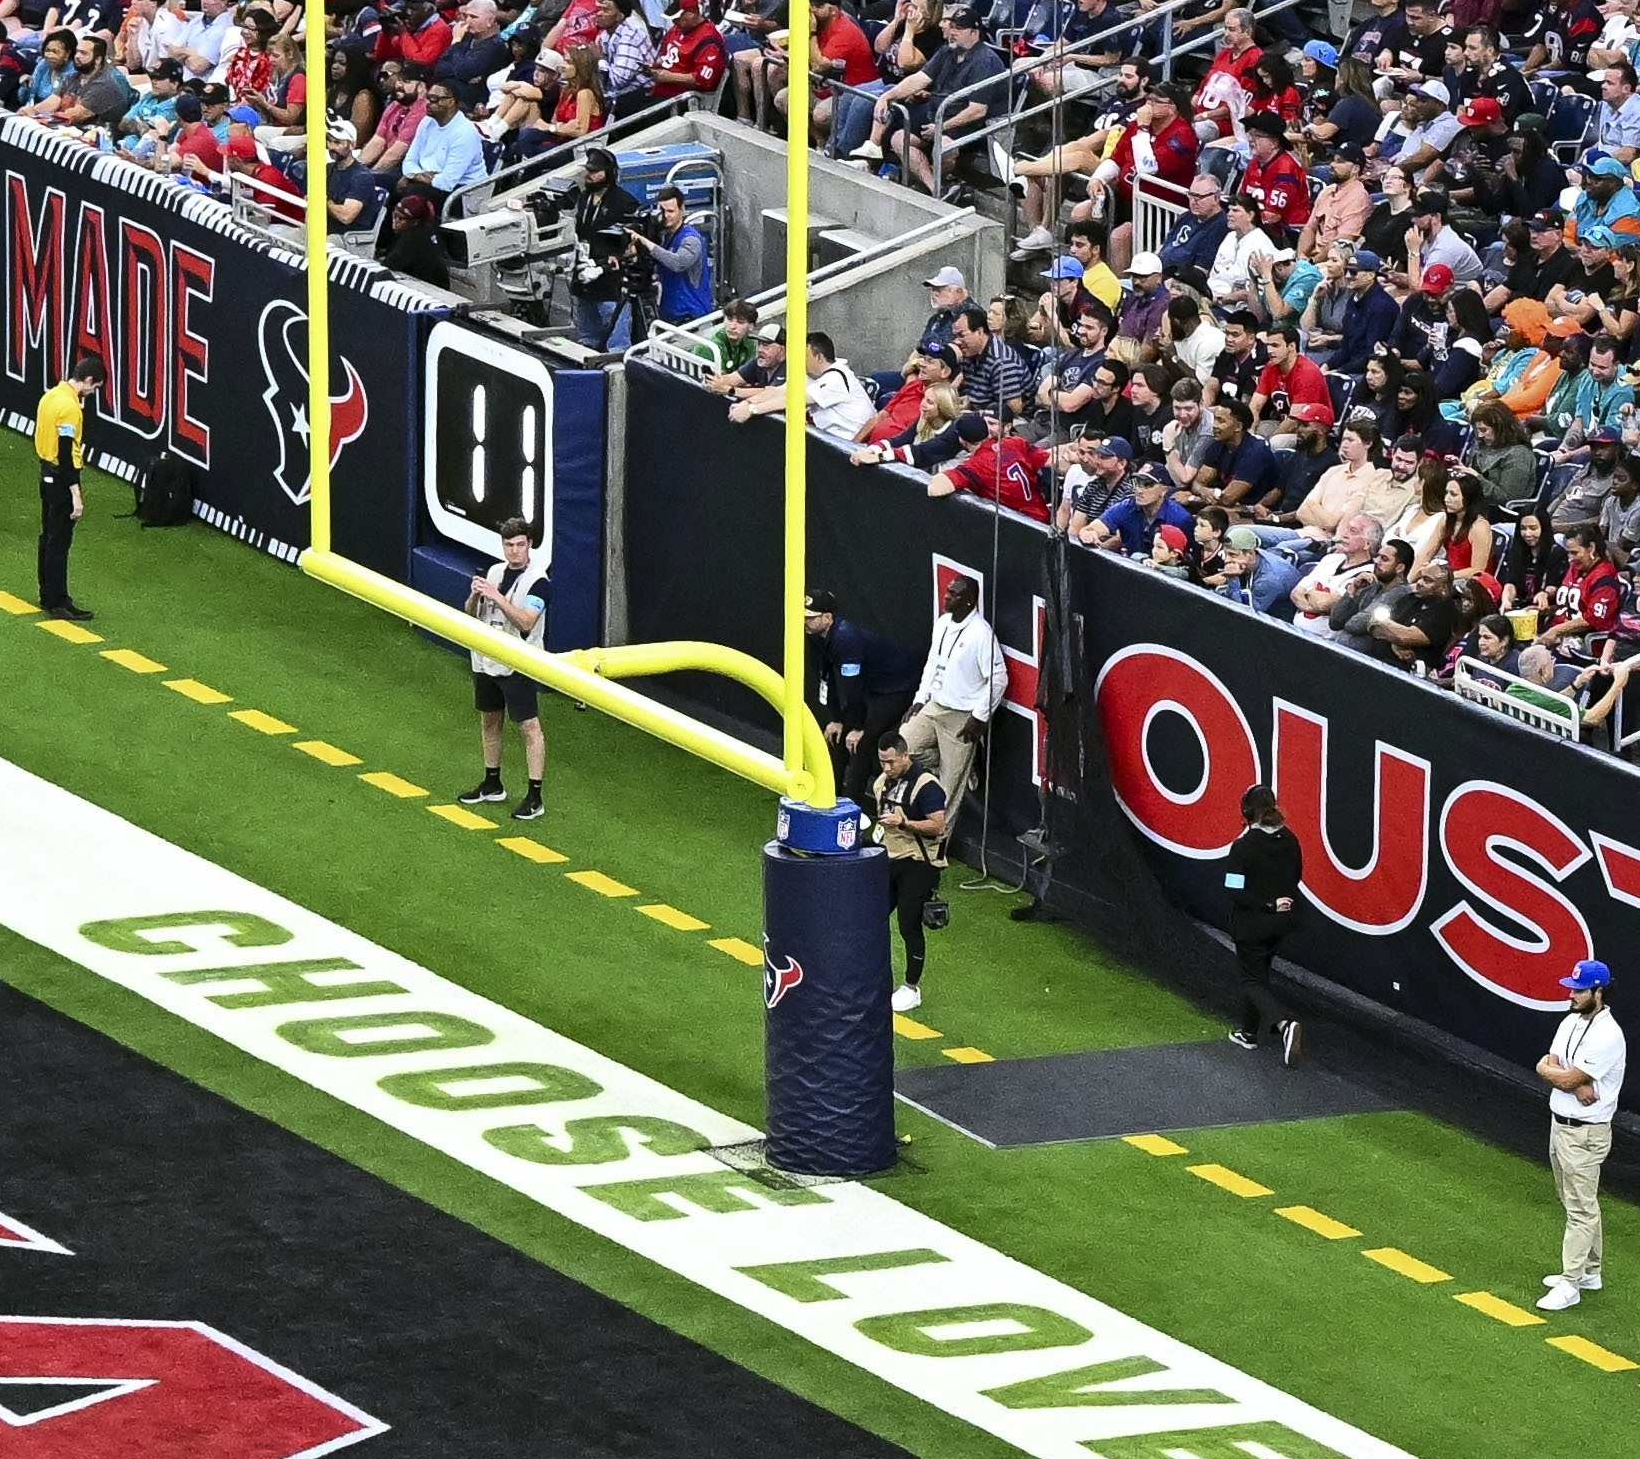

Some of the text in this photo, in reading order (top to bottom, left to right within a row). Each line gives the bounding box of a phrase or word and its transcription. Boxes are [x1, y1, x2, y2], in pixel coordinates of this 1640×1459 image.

[700, 65, 714, 79] 10
[1270, 192, 1288, 208] 56
[5, 170, 216, 472] MADE
[470, 382, 537, 525] 11
[1006, 461, 1032, 501] 7
[1556, 585, 1581, 615] 99
[78, 909, 834, 1224] CHOOSE
